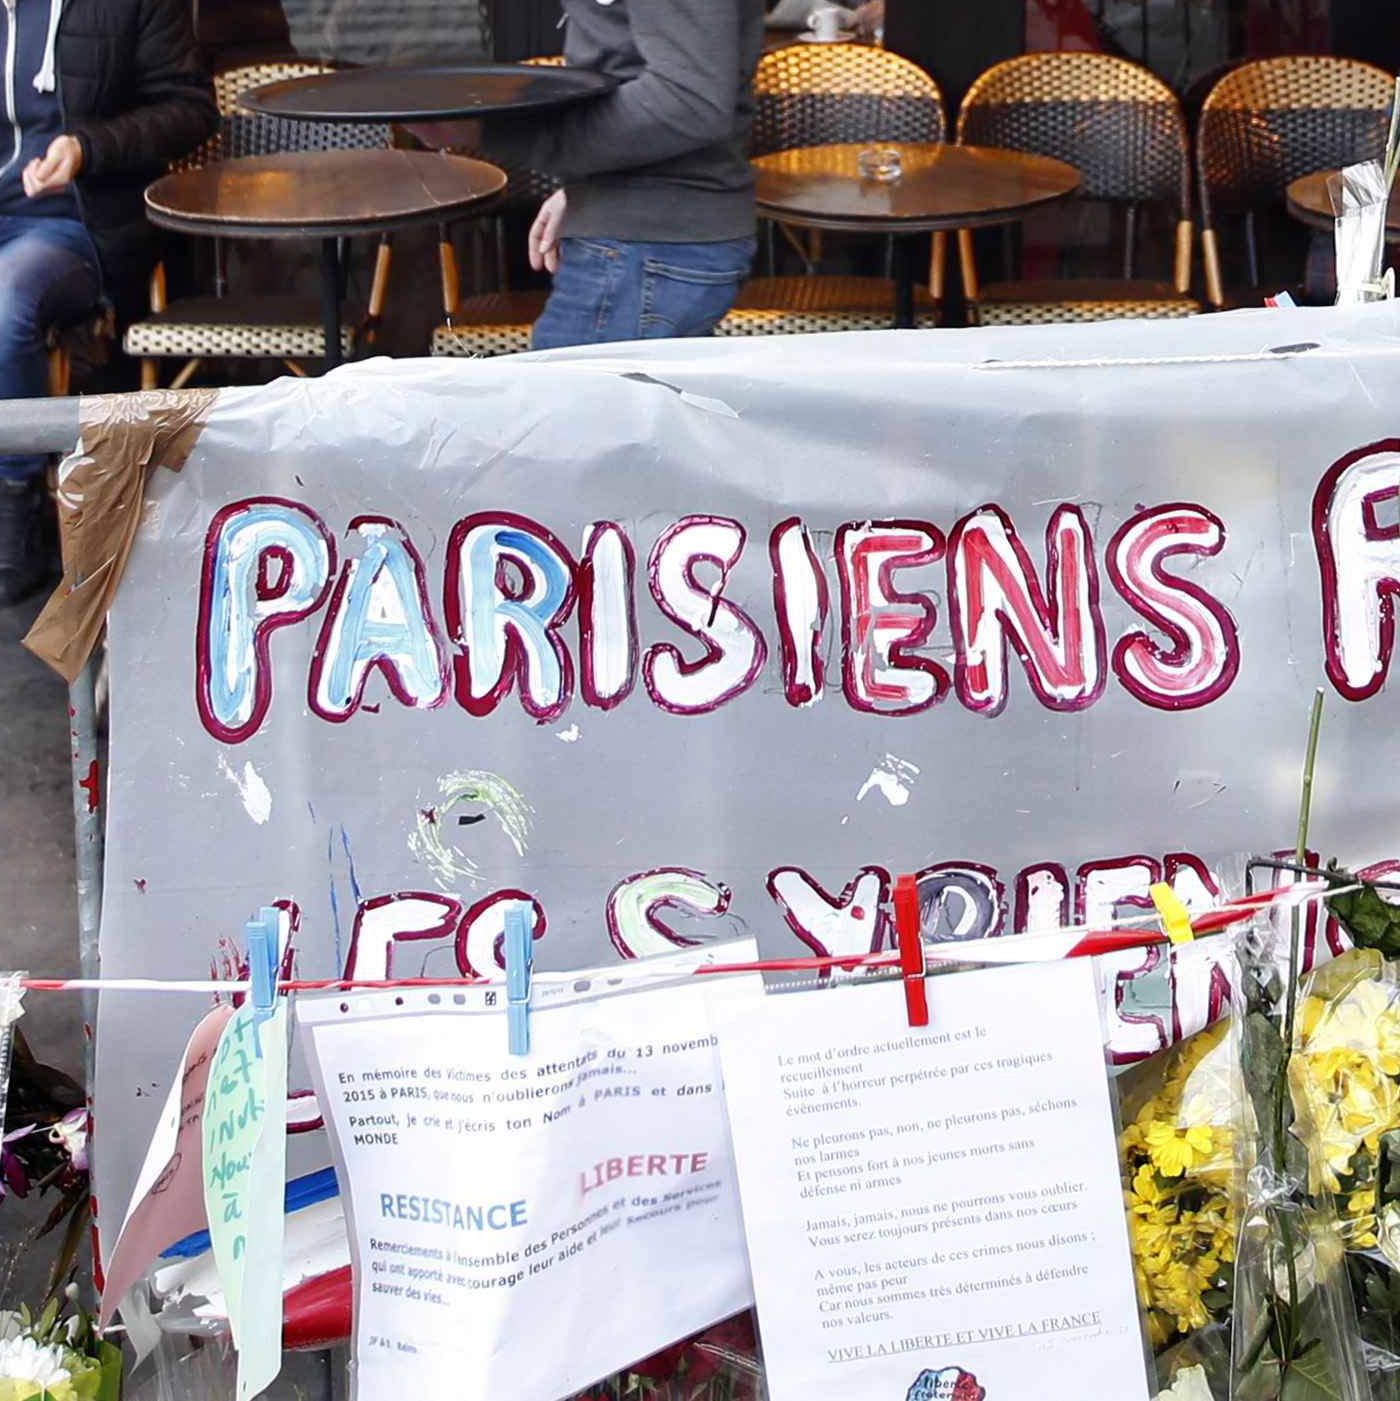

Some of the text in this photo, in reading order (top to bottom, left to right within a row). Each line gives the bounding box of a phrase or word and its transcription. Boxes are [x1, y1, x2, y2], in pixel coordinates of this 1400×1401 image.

[198, 496, 1242, 745] PARISIENS
[338, 1072, 355, 1084] En
[362, 1068, 418, 1082] mémoire
[424, 1066, 442, 1079] des
[500, 1069, 527, 1081] des
[537, 1049, 598, 1077] attentats
[607, 1047, 626, 1059] du
[636, 1045, 653, 1058] 13
[797, 1031, 952, 1065] mot d'ordre actuellement
[780, 1062, 864, 1084] recueillement
[832, 1076, 886, 1094] l'horreur
[889, 1065, 948, 1087] perpétrée
[996, 1052, 1054, 1069] tragiques
[343, 1089, 376, 1103] 2015
[349, 1113, 400, 1129] Partout,
[506, 1116, 532, 1131] ton
[543, 1104, 572, 1125] Nom
[593, 1085, 641, 1103] PARIS
[650, 1086, 667, 1097] et
[676, 1083, 712, 1097] dans
[353, 1133, 399, 1146] MONDE
[812, 1129, 867, 1149] pleurons
[944, 1110, 999, 1131] pleurons
[579, 1152, 709, 1198] LIBERTE
[793, 1148, 861, 1167] nos larmes
[813, 1139, 1036, 1182] pensons fort nos jeunes morts sans
[799, 1176, 903, 1200] défense armes
[805, 1182, 1088, 1233] Jamais, jamais, nous pourrons vous oublier.
[380, 1193, 528, 1232] RESISTANCE
[523, 1239, 548, 1259] des
[631, 1196, 658, 1208] des
[807, 1200, 1079, 1248] Vous serez toujours présents dans nos cœurs
[827, 1232, 1088, 1278] vous, acteurs crimes nous disons
[816, 1275, 908, 1298] même pas peur
[818, 1264, 1089, 1313] Car nous sommes très déterminés défendre
[821, 1310, 894, 1329] nos valeurs.
[826, 1310, 1101, 1358] VIVE LIBERTE VIVE LA FRANCE
